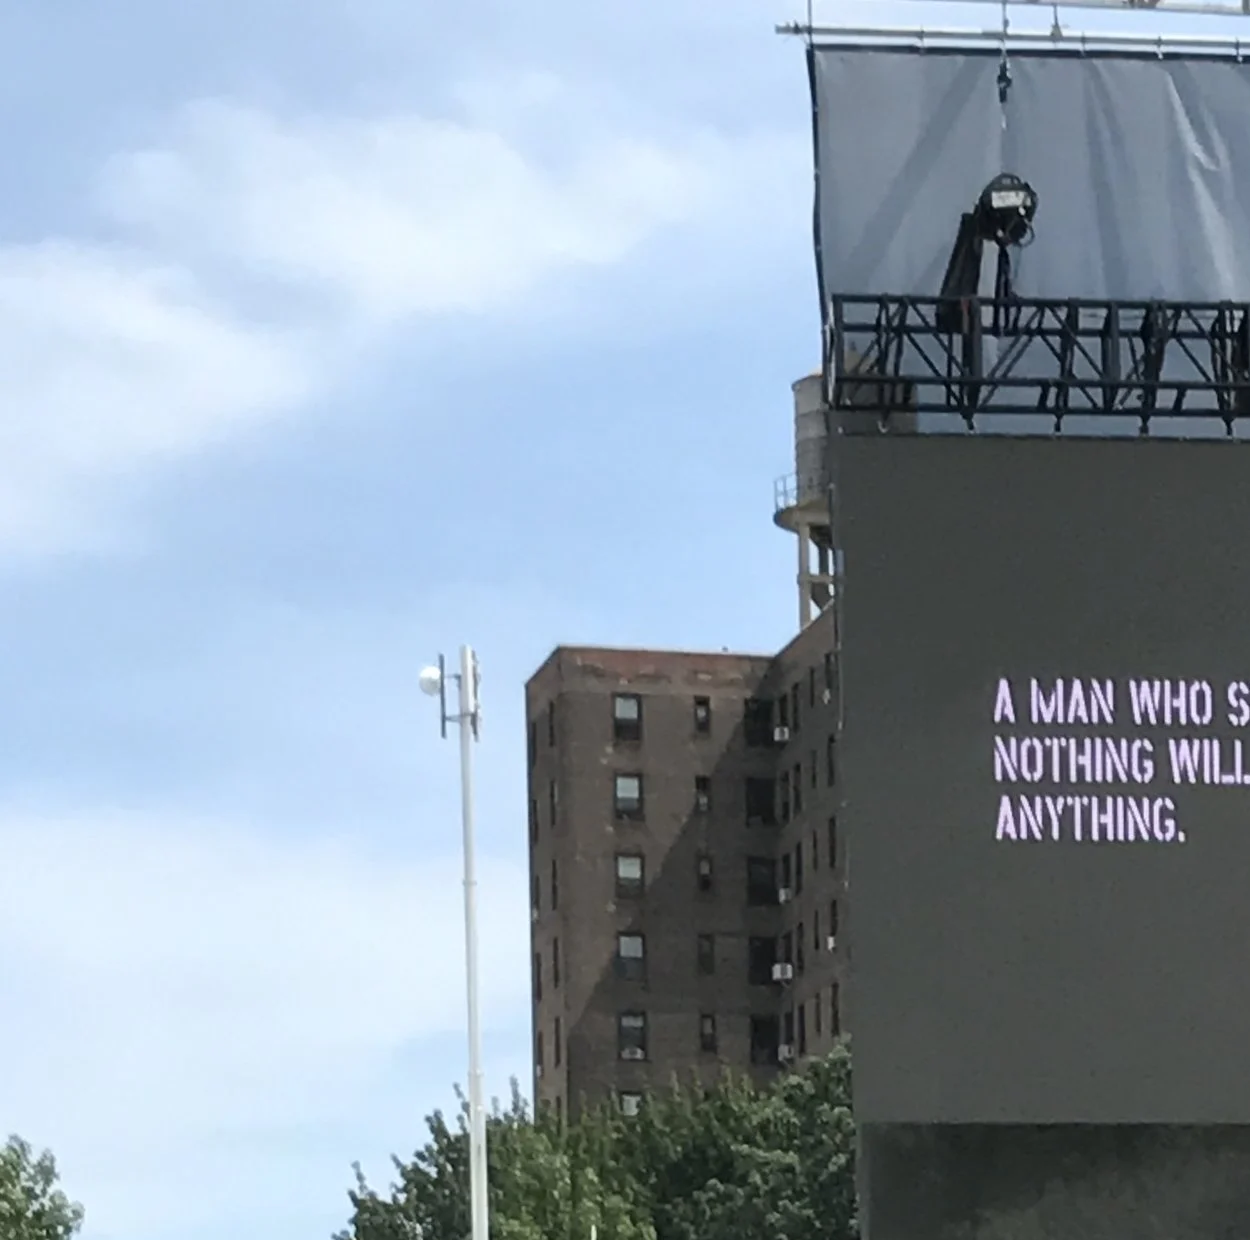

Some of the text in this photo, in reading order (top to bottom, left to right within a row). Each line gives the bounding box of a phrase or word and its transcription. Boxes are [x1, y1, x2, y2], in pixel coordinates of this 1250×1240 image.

[993, 677, 1016, 724] A
[1030, 677, 1114, 725] MAN
[1129, 679, 1213, 726] WHO
[993, 735, 1154, 784] NOTHING
[995, 794, 1186, 843] ANYTHING.
